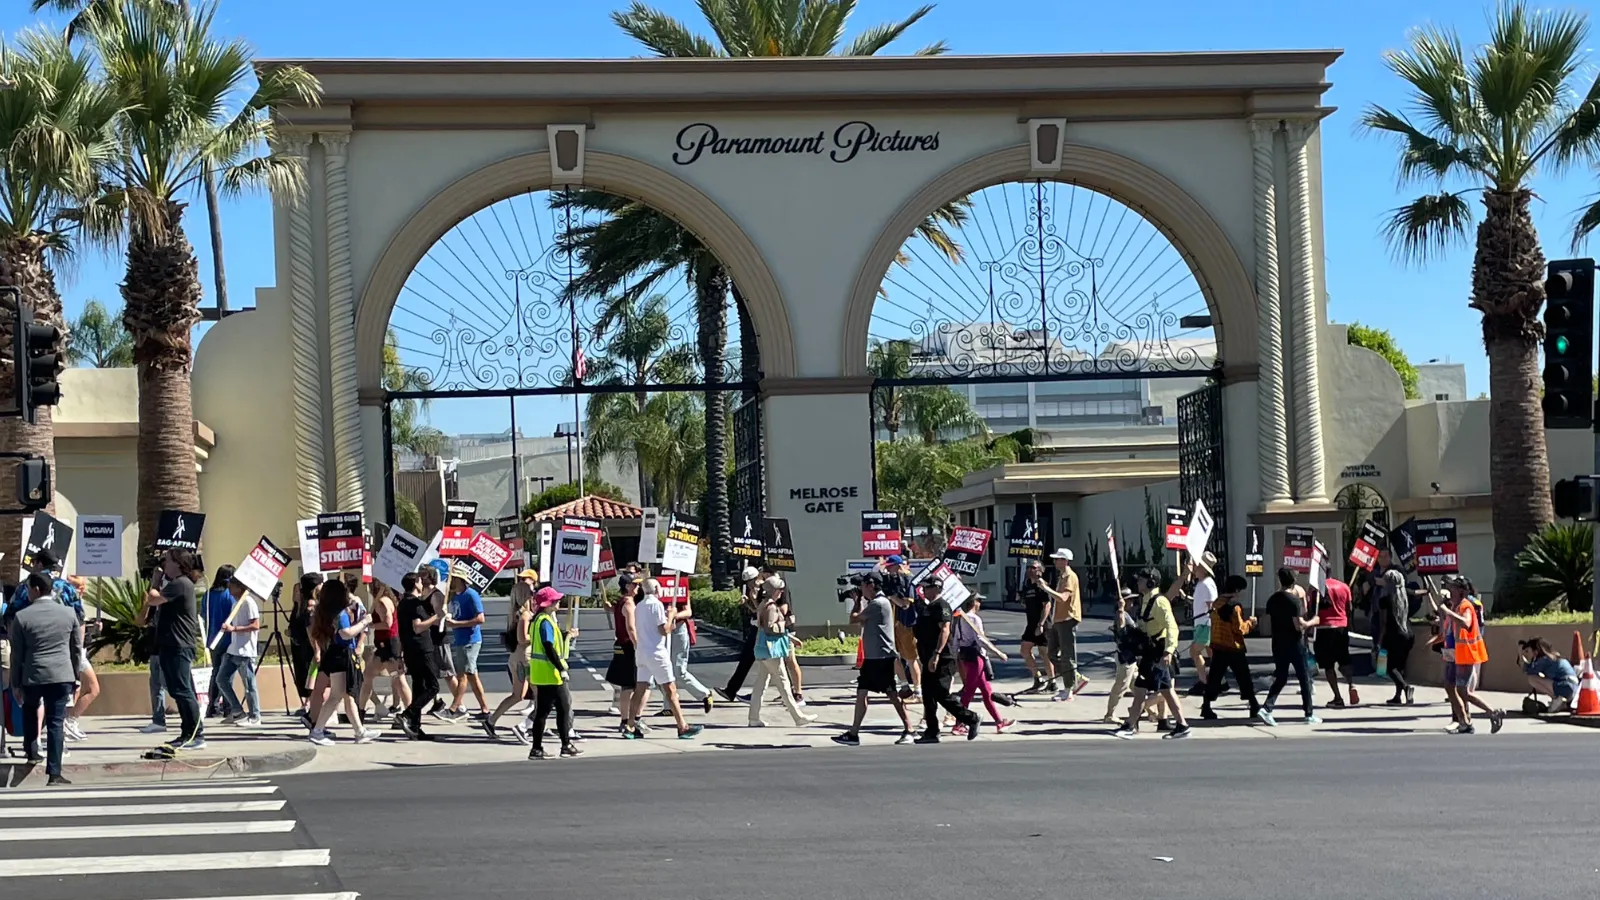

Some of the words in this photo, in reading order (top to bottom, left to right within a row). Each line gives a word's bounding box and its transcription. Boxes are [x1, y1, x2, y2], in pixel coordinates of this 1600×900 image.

[672, 123, 825, 166] Paramount
[829, 121, 940, 163] Pictures
[790, 486, 859, 500] MELROSE
[804, 501, 845, 513] GATE
[319, 516, 343, 524] WRITERS
[84, 526, 113, 534] WGAW
[328, 528, 353, 537] AMERICA
[955, 530, 986, 540] WRITERS
[668, 529, 698, 544] STRIKE!
[1167, 534, 1188, 545] STRIKE
[156, 538, 197, 549] SAG-AFTRA
[336, 541, 347, 549] ON
[441, 537, 470, 549] STRIKE!
[863, 540, 899, 550] STRIKE!
[950, 540, 982, 552] AMERICA
[320, 548, 363, 563] STRIKE!
[733, 546, 762, 557] STRIKE!
[1009, 547, 1042, 556] STRIKE!
[251, 547, 283, 576] STRIKE!
[944, 557, 977, 573] STRIKE
[1283, 556, 1311, 568] STRIKE!
[1418, 553, 1457, 567] STRIKE!
[557, 563, 591, 580] HONK
[660, 586, 687, 598] TRIE!
